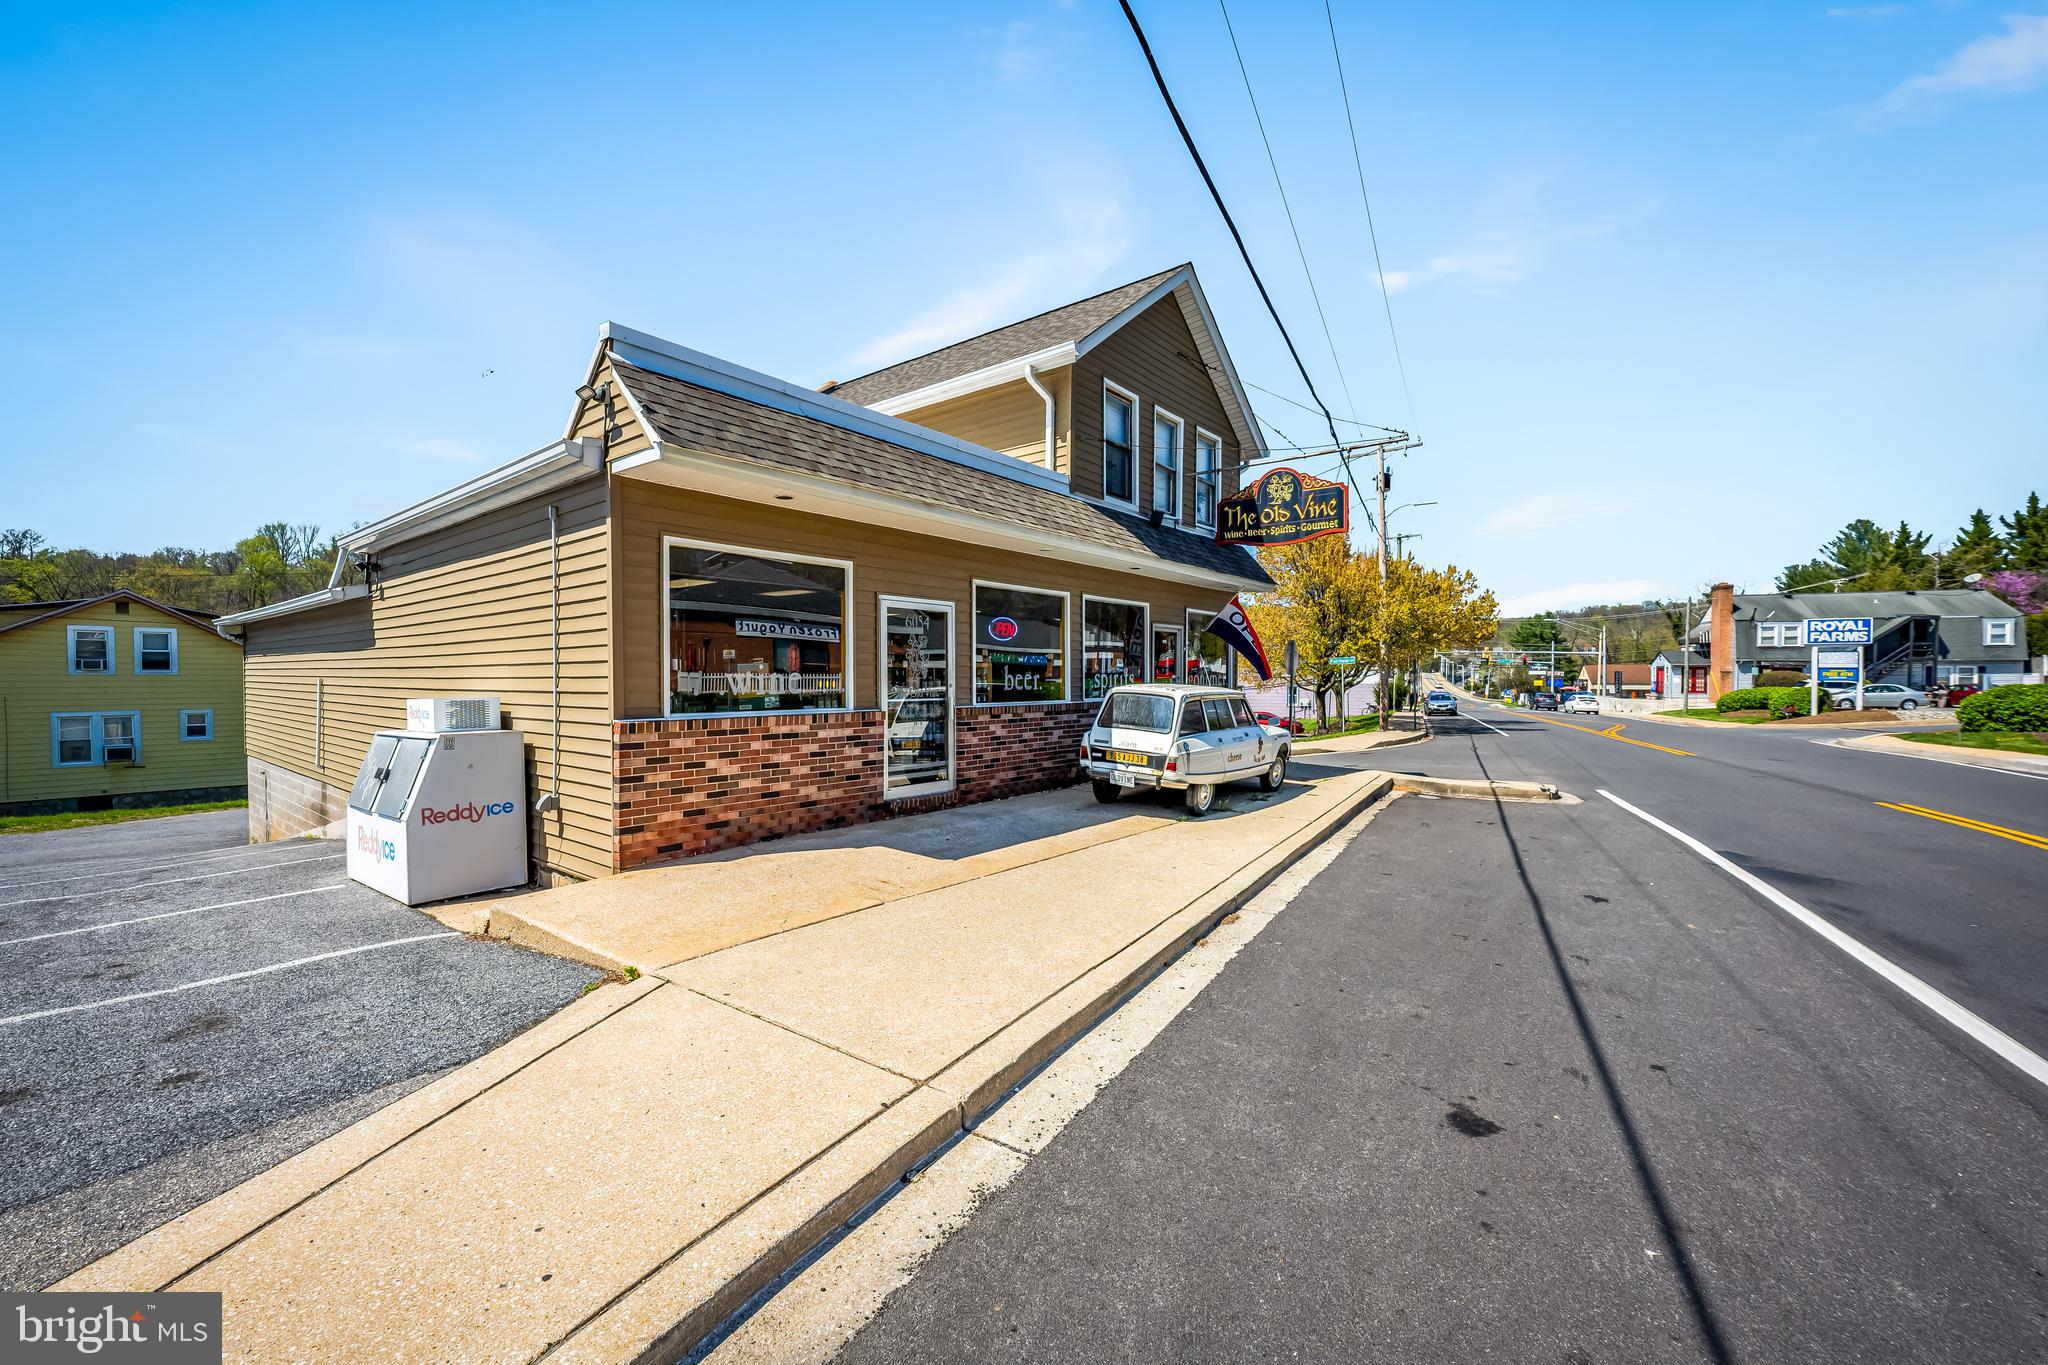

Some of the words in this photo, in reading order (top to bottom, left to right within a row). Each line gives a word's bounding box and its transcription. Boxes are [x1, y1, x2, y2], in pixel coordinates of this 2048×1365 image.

[1224, 505, 1257, 530] The
[1259, 504, 1290, 524] Old
[1293, 492, 1337, 519] Vine
[1224, 530, 1244, 540] Wine
[1247, 527, 1266, 537] Beer
[1270, 525, 1296, 536] Spirits
[1301, 520, 1339, 532] Gourmet
[905, 613, 930, 630] 6054
[1809, 620, 1869, 631] ROYAL
[1809, 631, 1869, 642] FARMS
[725, 671, 802, 695] wine
[1003, 665, 1040, 691] beer
[1094, 673, 1135, 697] spirits
